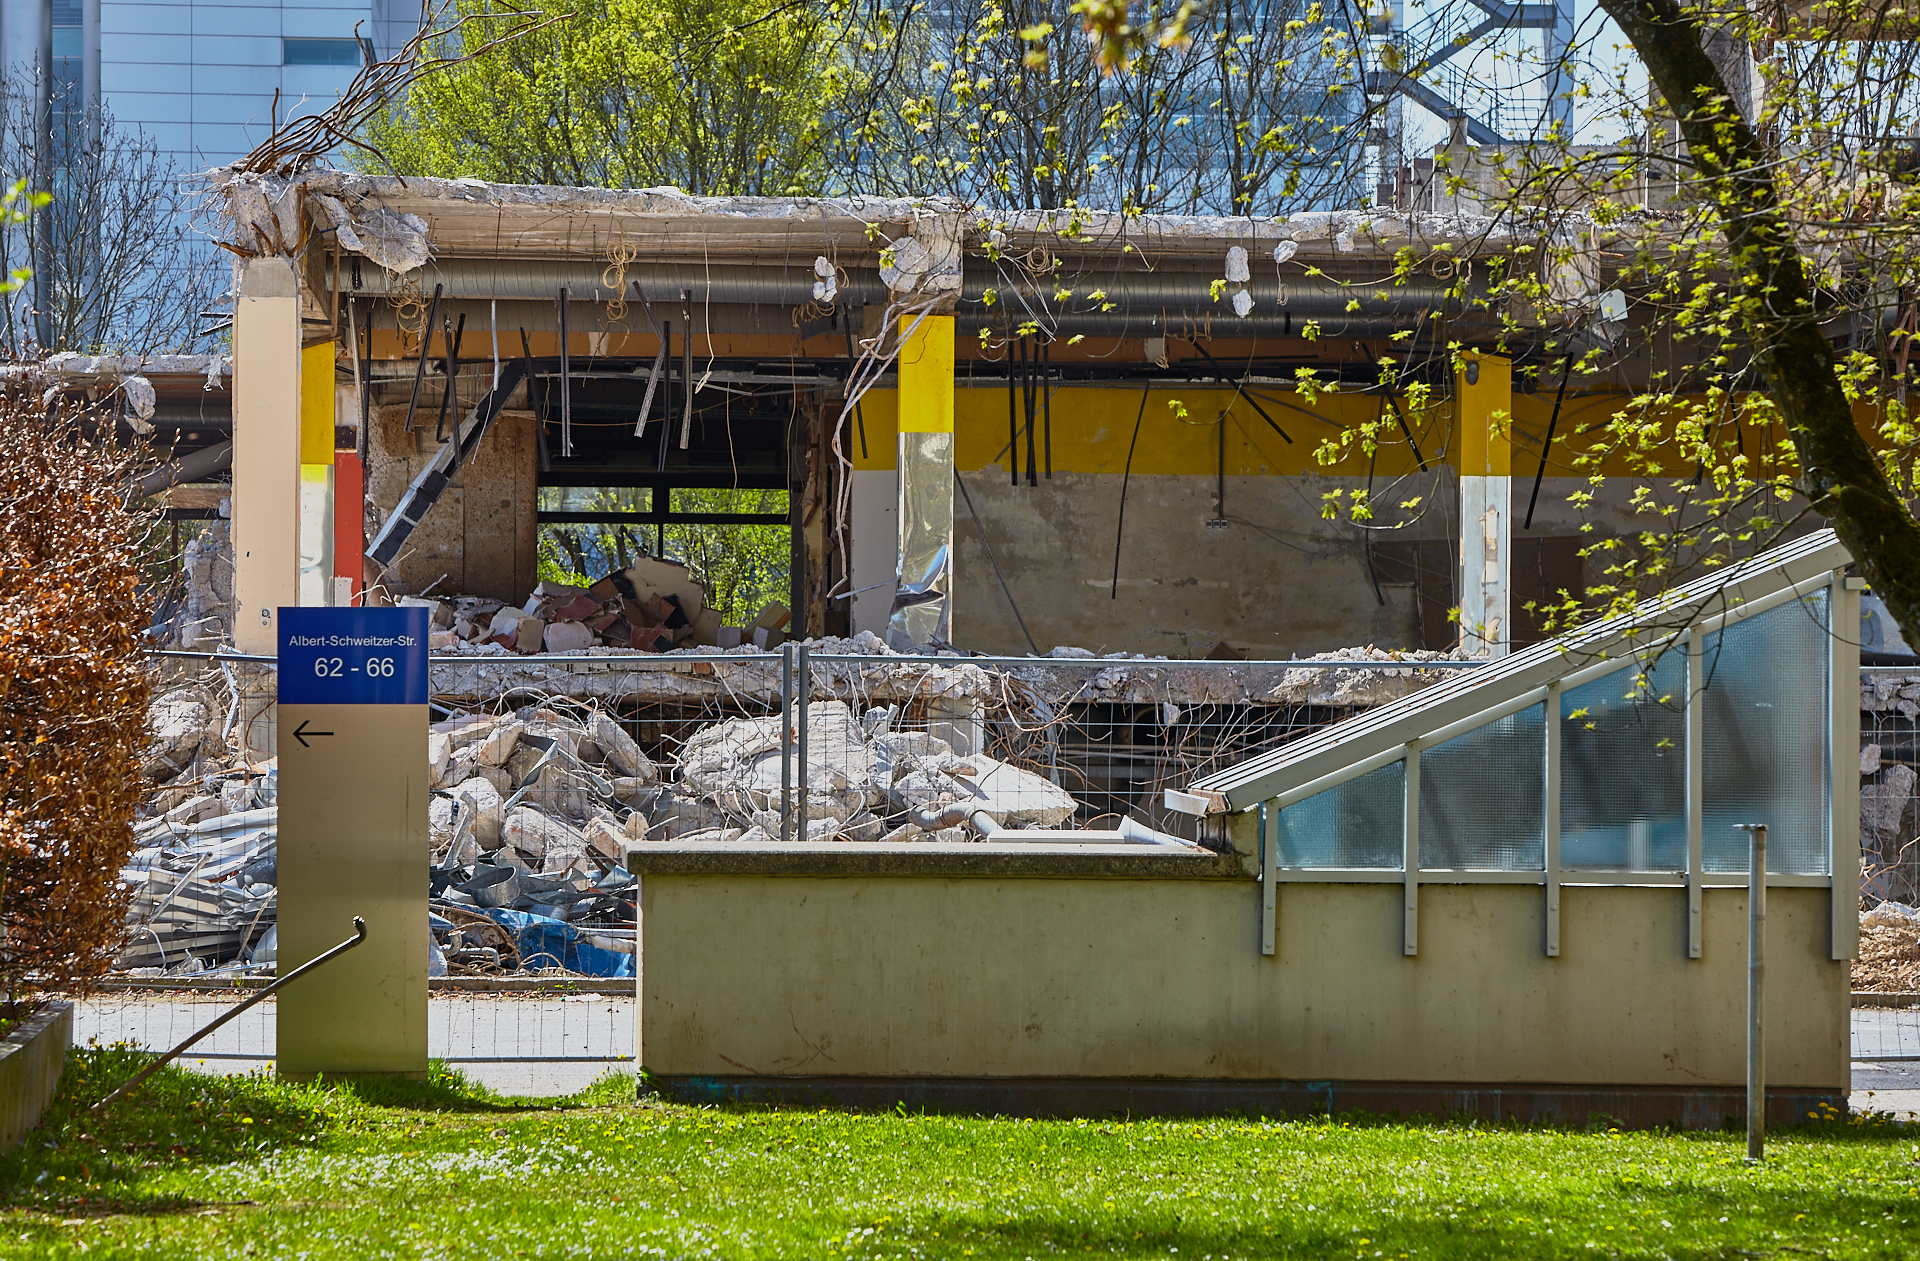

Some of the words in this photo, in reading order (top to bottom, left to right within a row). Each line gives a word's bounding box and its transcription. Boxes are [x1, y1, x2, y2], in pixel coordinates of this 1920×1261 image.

[288, 635, 417, 647] Albert-Schweitzer-Str.
[314, 657, 344, 677] 62
[366, 657, 395, 677] 66
